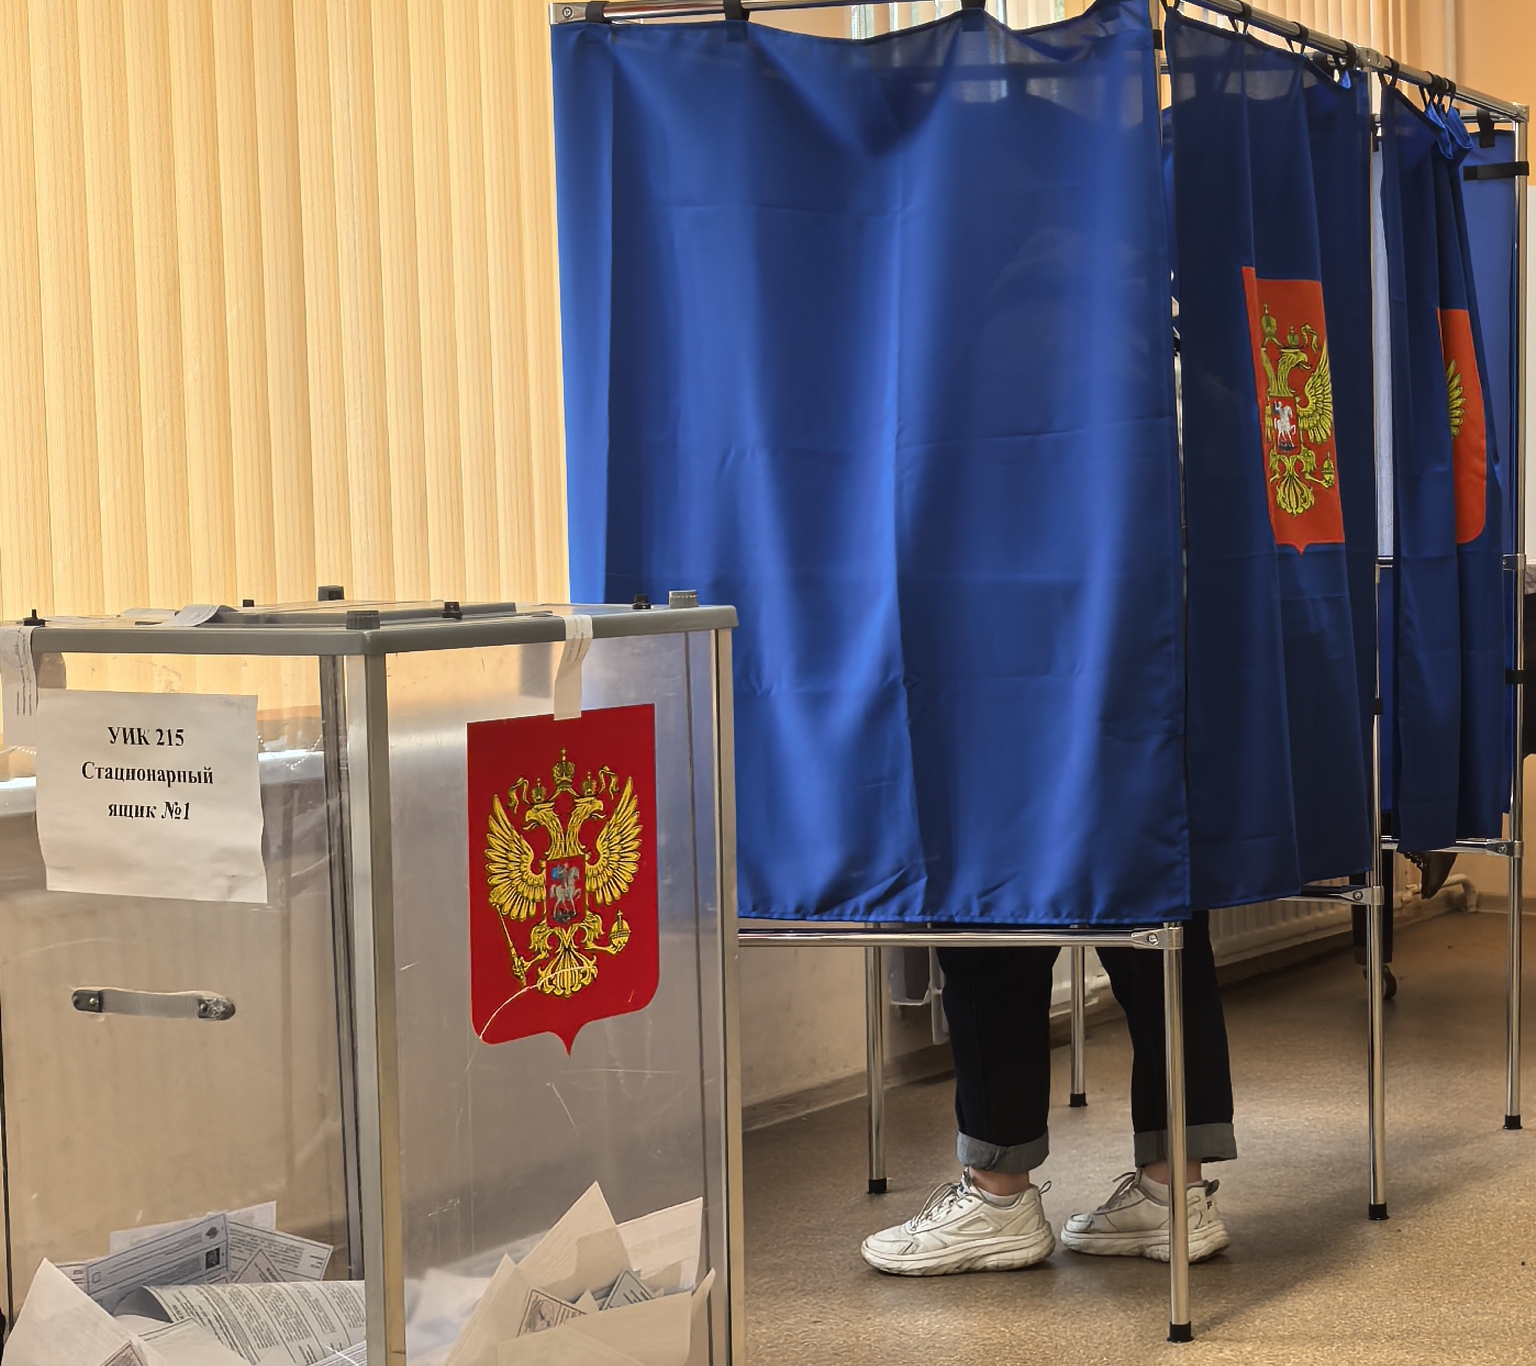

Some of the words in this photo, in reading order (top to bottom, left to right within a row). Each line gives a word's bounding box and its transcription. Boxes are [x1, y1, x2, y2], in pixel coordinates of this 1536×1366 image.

[107, 726, 150, 745] УИК
[155, 728, 184, 747] 215
[82, 761, 213, 788] Стационарный
[108, 803, 157, 819] ящик
[161, 801, 190, 820] №1
